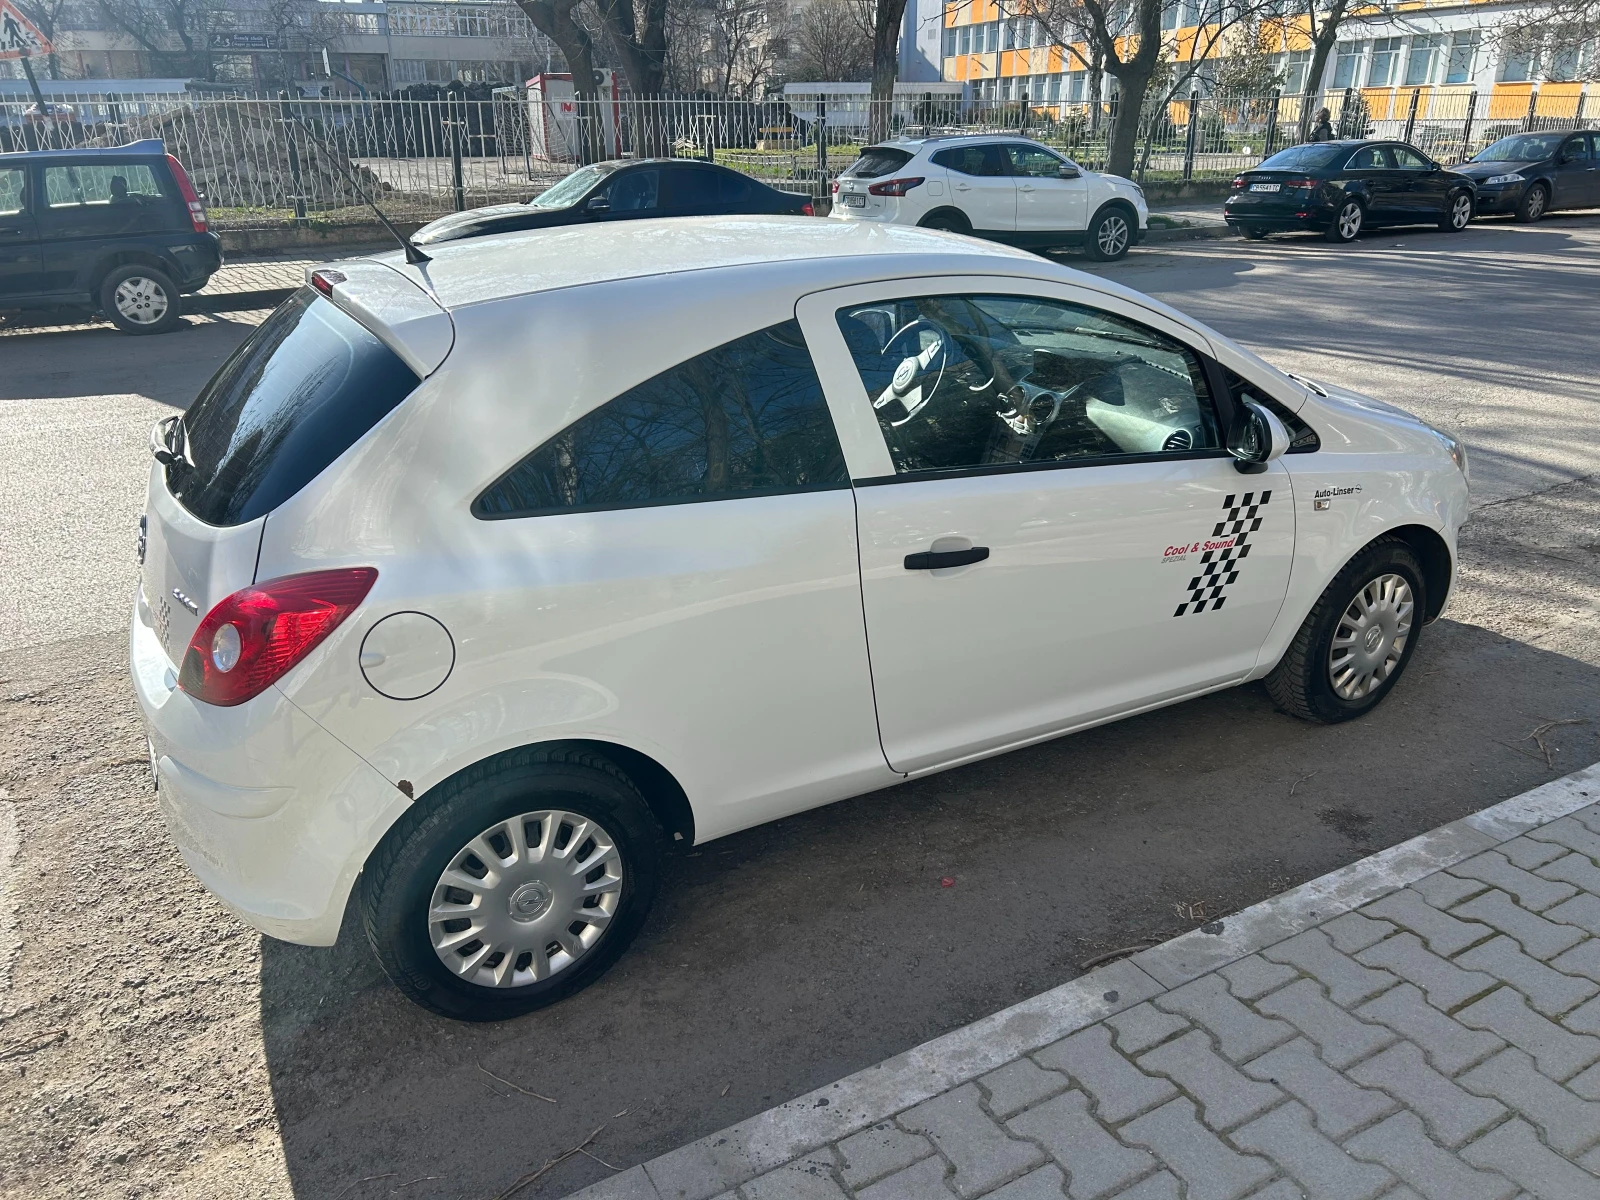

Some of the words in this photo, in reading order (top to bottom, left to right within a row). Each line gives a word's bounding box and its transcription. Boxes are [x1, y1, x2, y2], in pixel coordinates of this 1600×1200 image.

[1314, 486, 1355, 499] Auto-Linser
[1164, 543, 1190, 556] Cool
[1190, 542, 1200, 553] &
[1202, 537, 1235, 551] Sound
[1161, 555, 1186, 564] SPEZIAL
